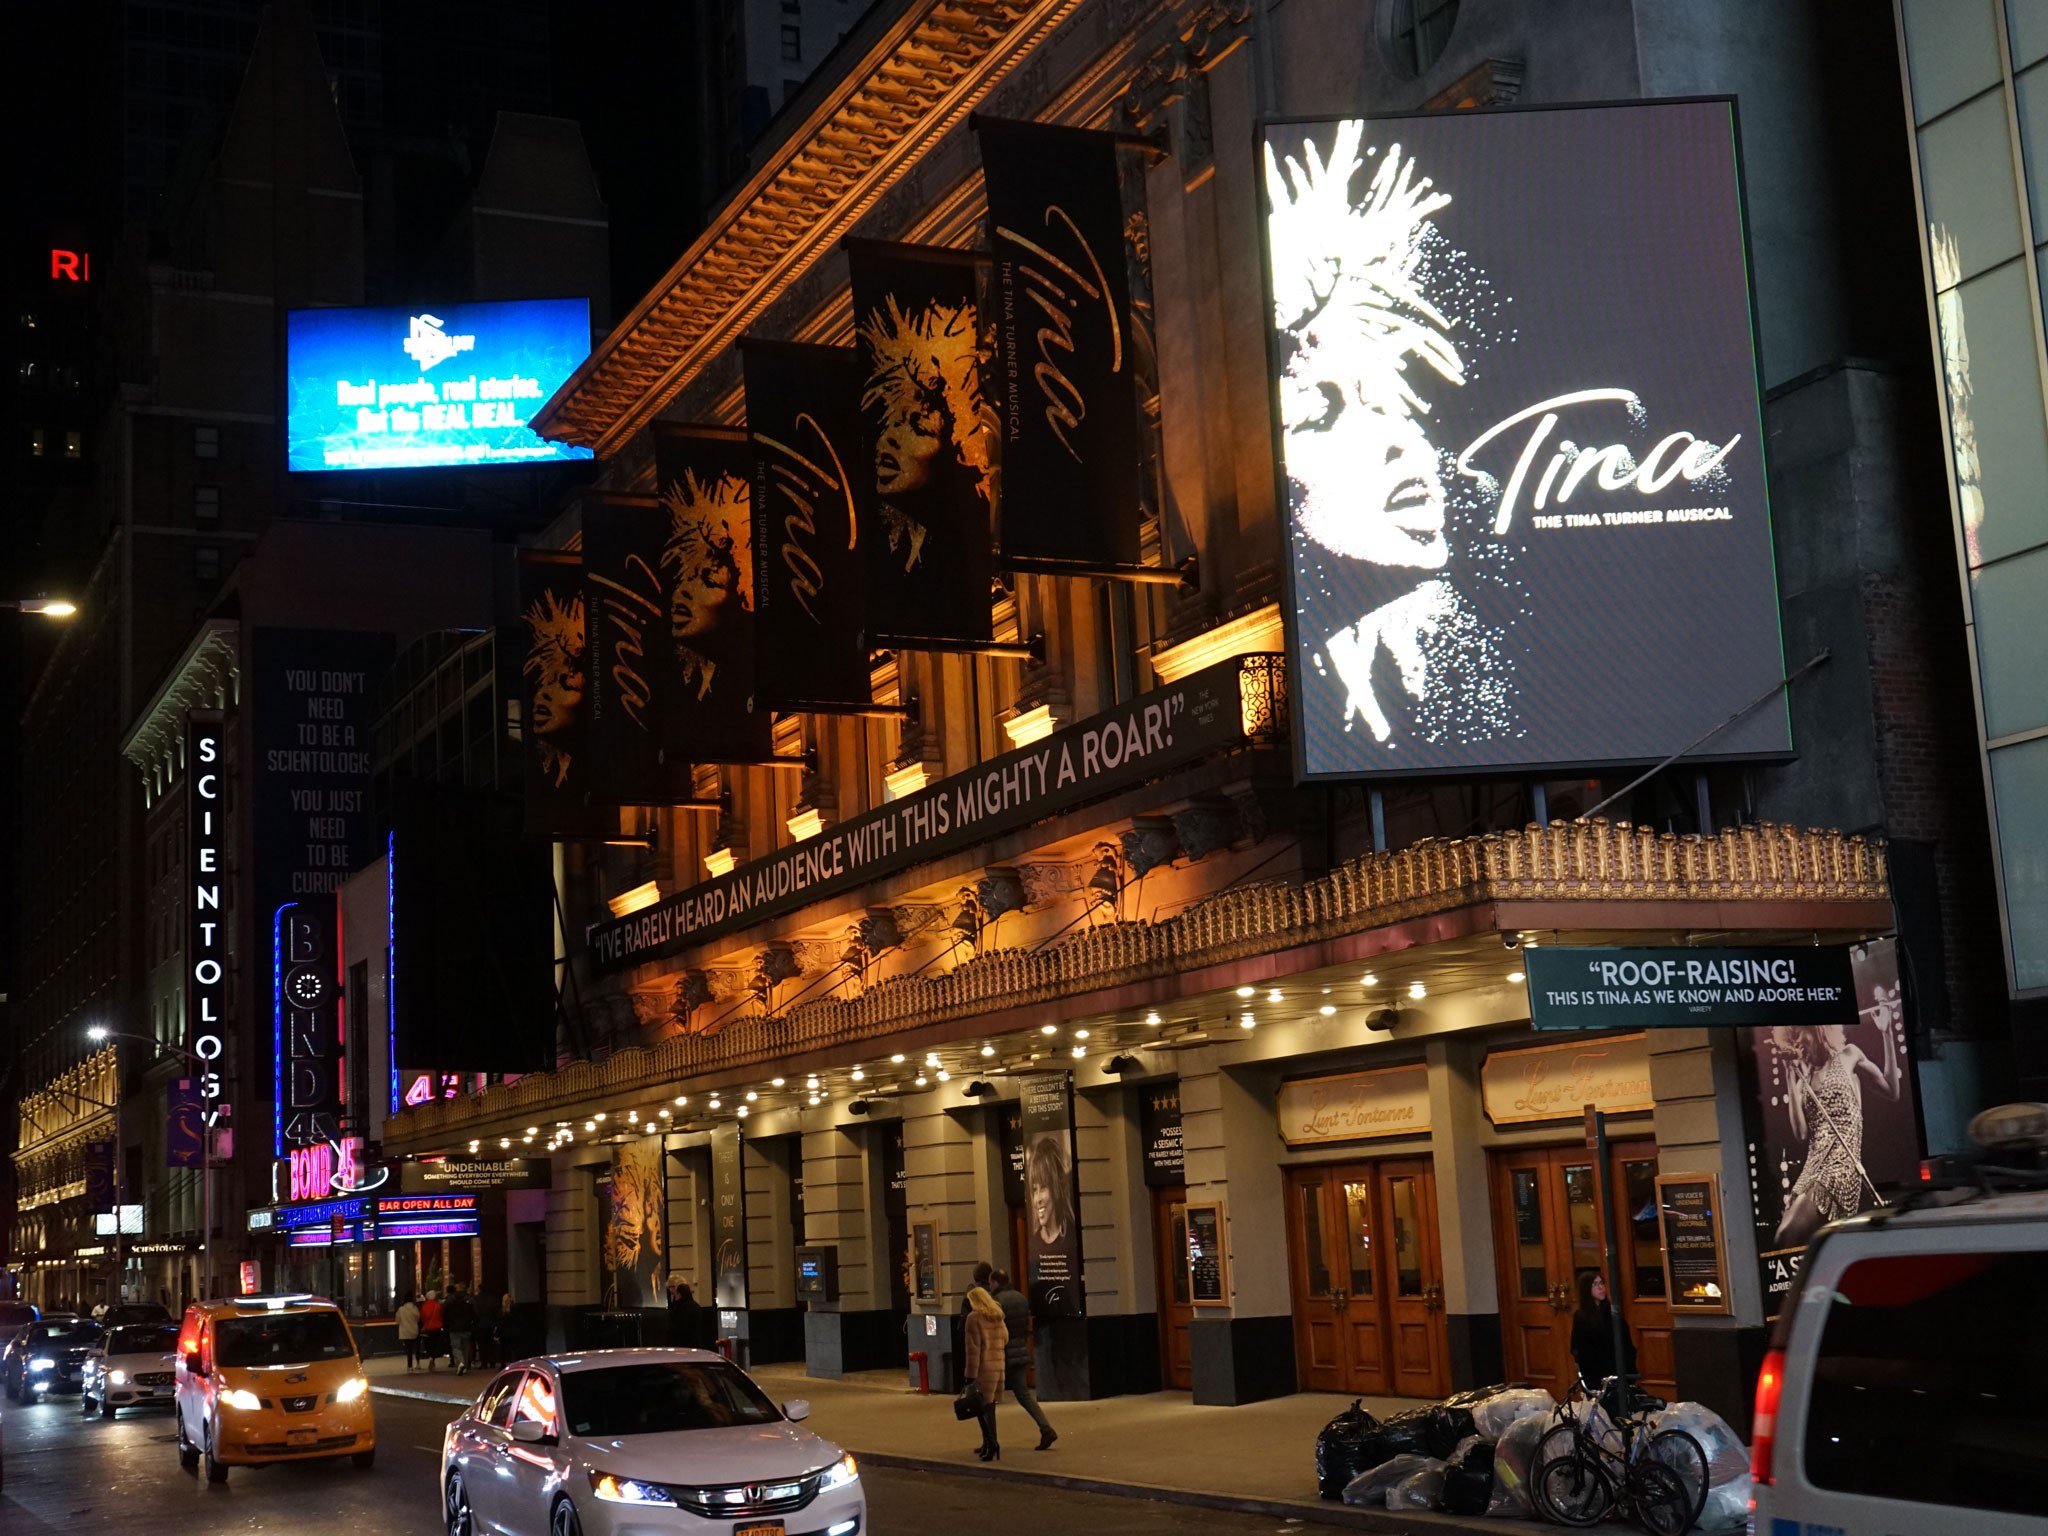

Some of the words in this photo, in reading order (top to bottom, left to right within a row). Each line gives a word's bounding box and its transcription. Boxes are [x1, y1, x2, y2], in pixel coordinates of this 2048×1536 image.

[1001, 261, 1013, 286] THE
[1003, 288, 1015, 320] TINA
[996, 204, 1122, 464] Tina
[1005, 326, 1018, 379] TURNER
[1007, 385, 1020, 443] MUSICAL
[757, 461, 766, 481] THE
[1457, 388, 1741, 535] Tina
[758, 484, 767, 511] TINA
[753, 412, 859, 624] Tina
[1532, 515, 1562, 529] THE
[1565, 513, 1601, 528] TINA
[1603, 510, 1663, 526] TURNER
[1666, 507, 1733, 523] MUSICAL
[759, 513, 768, 554] TURNER
[760, 555, 770, 608] MUSICAL
[587, 553, 663, 732] Tina
[286, 669, 317, 692] YOU
[321, 670, 366, 694] DON'T
[308, 698, 344, 719] NEED
[297, 724, 318, 745] TO
[322, 724, 340, 746] BE
[344, 725, 355, 746] A
[291, 789, 322, 812] YOU
[327, 790, 363, 812] JUST
[310, 817, 345, 839] NEED
[306, 845, 325, 866] TO
[331, 845, 349, 867] BE
[625, 907, 672, 955] RARELY
[675, 888, 725, 936] HEARD
[728, 876, 751, 917] AN
[755, 837, 843, 906] AUDIENCE
[847, 814, 897, 869] WITH
[901, 792, 950, 848] THIS
[956, 749, 1050, 828] MIGHTY
[1057, 742, 1077, 788] A
[292, 871, 356, 893] CURIO
[195, 737, 222, 1128] SCIENTOLOGY
[1588, 959, 1797, 986] “ROOF-RAISING!
[1547, 991, 1579, 1006] THIS
[1582, 991, 1594, 1005] IS
[1596, 990, 1631, 1005] TINA
[1633, 990, 1650, 1004] AS
[1653, 990, 1675, 1004] WE
[1678, 988, 1721, 1004] KNOW
[1724, 988, 1755, 1003] AND
[1758, 987, 1804, 1002] ADORE
[291, 1143, 331, 1201] BOND
[337, 1137, 357, 1189] 45
[379, 1201, 400, 1211] BAR
[402, 1200, 431, 1210] OPEN
[433, 1199, 452, 1209] ALL
[453, 1198, 475, 1208] DAY
[722, 1216, 734, 1227] ONE
[131, 1243, 186, 1253] SCIENTOLOGY
[1768, 1258, 1789, 1280] “A
